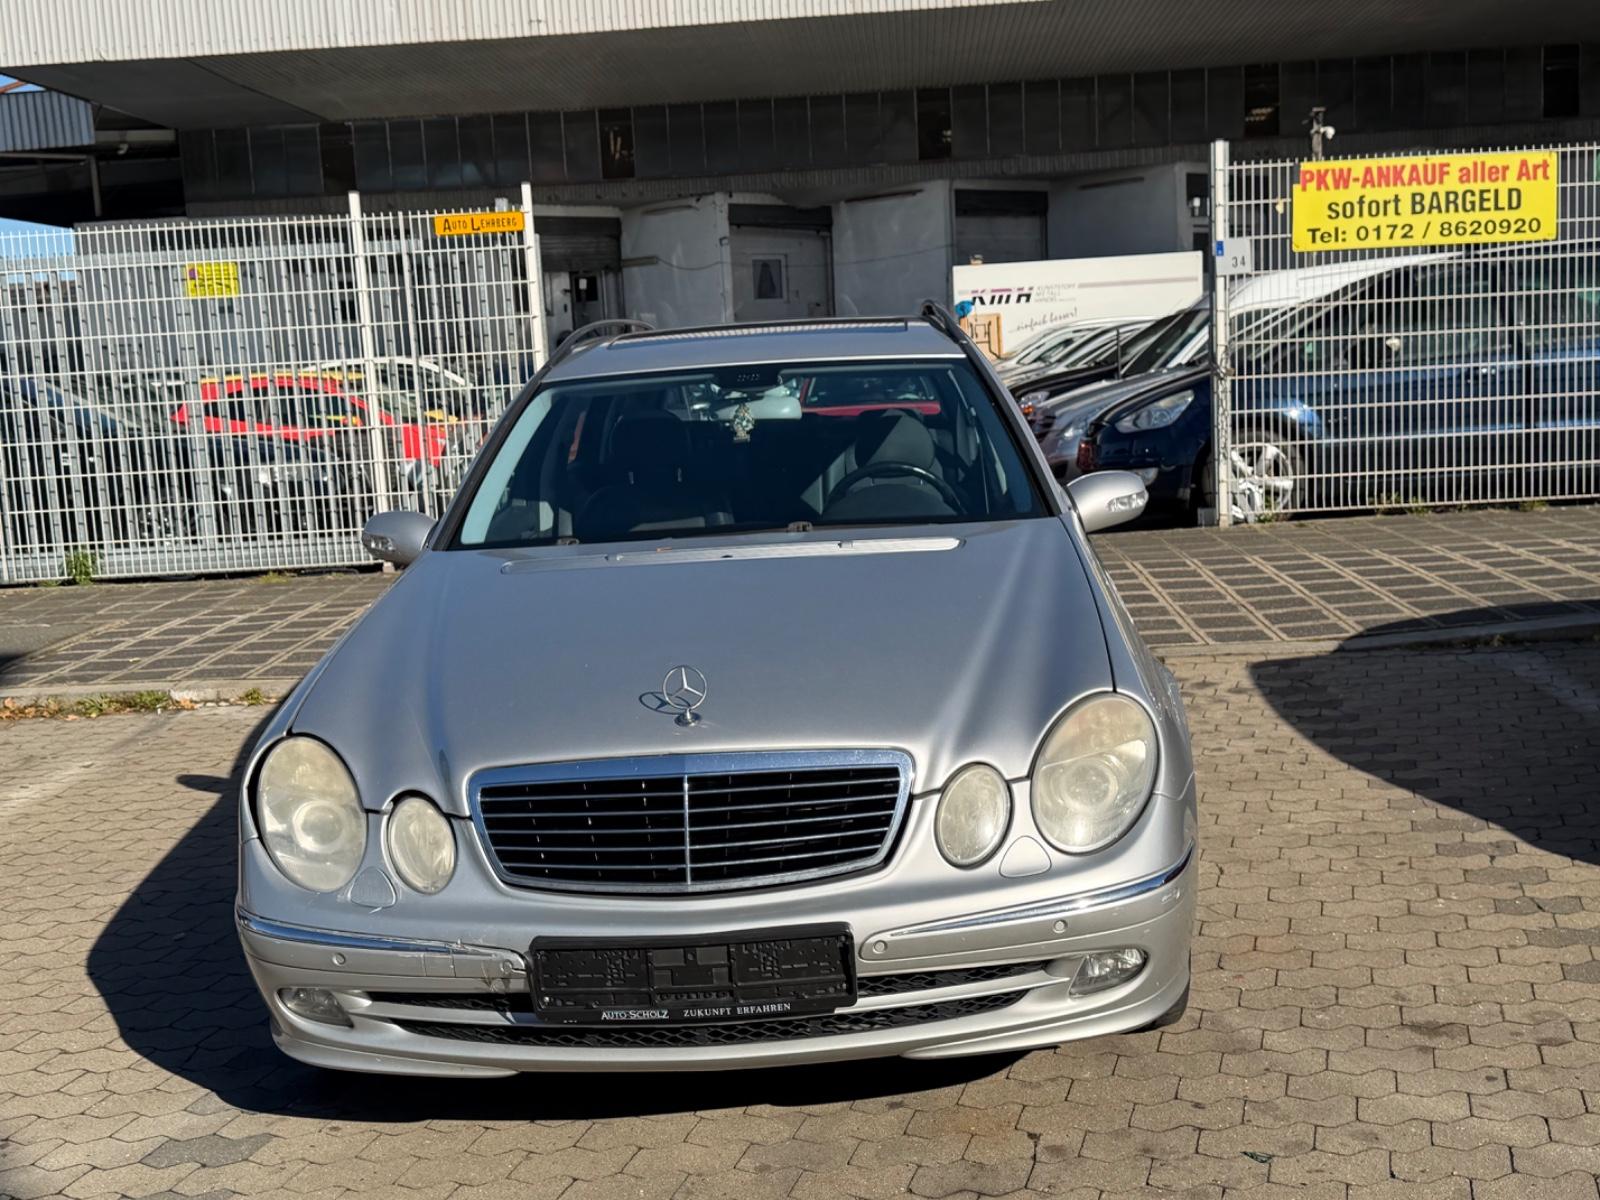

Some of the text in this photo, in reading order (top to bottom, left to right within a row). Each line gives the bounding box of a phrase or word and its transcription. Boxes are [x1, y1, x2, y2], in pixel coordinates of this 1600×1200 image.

[1300, 158, 1549, 192] PKW-ANKAUF aller Art
[1327, 187, 1521, 219] sofort BARGELD
[443, 218, 467, 232] AUTO
[1307, 217, 1541, 243] Tel: 0172 / 8620920
[737, 1002, 791, 1014] ERFAHREN
